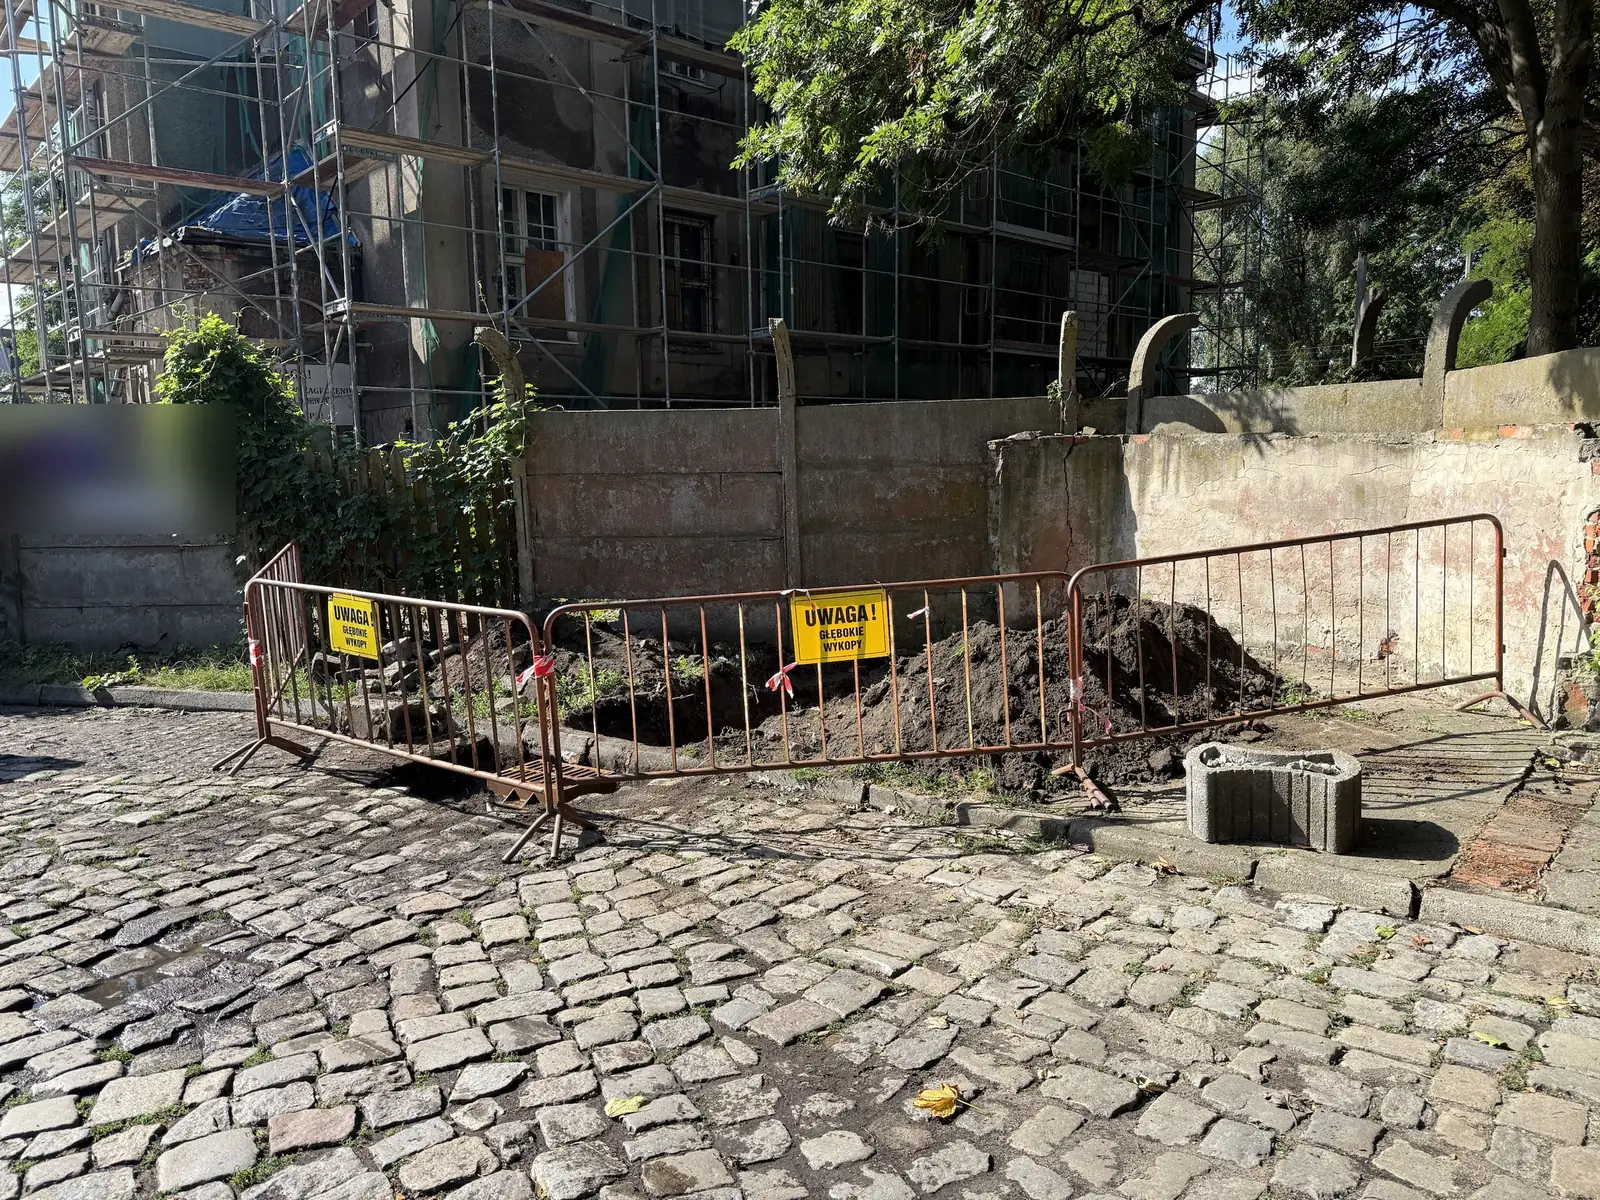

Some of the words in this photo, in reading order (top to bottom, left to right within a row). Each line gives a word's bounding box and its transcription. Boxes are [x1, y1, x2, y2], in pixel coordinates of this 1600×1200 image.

[805, 603, 877, 627] UWAGA!
[819, 626, 864, 641] GŁĘBOKIE
[345, 637, 367, 649] WYKOPY
[823, 639, 862, 652] WYKOPY
